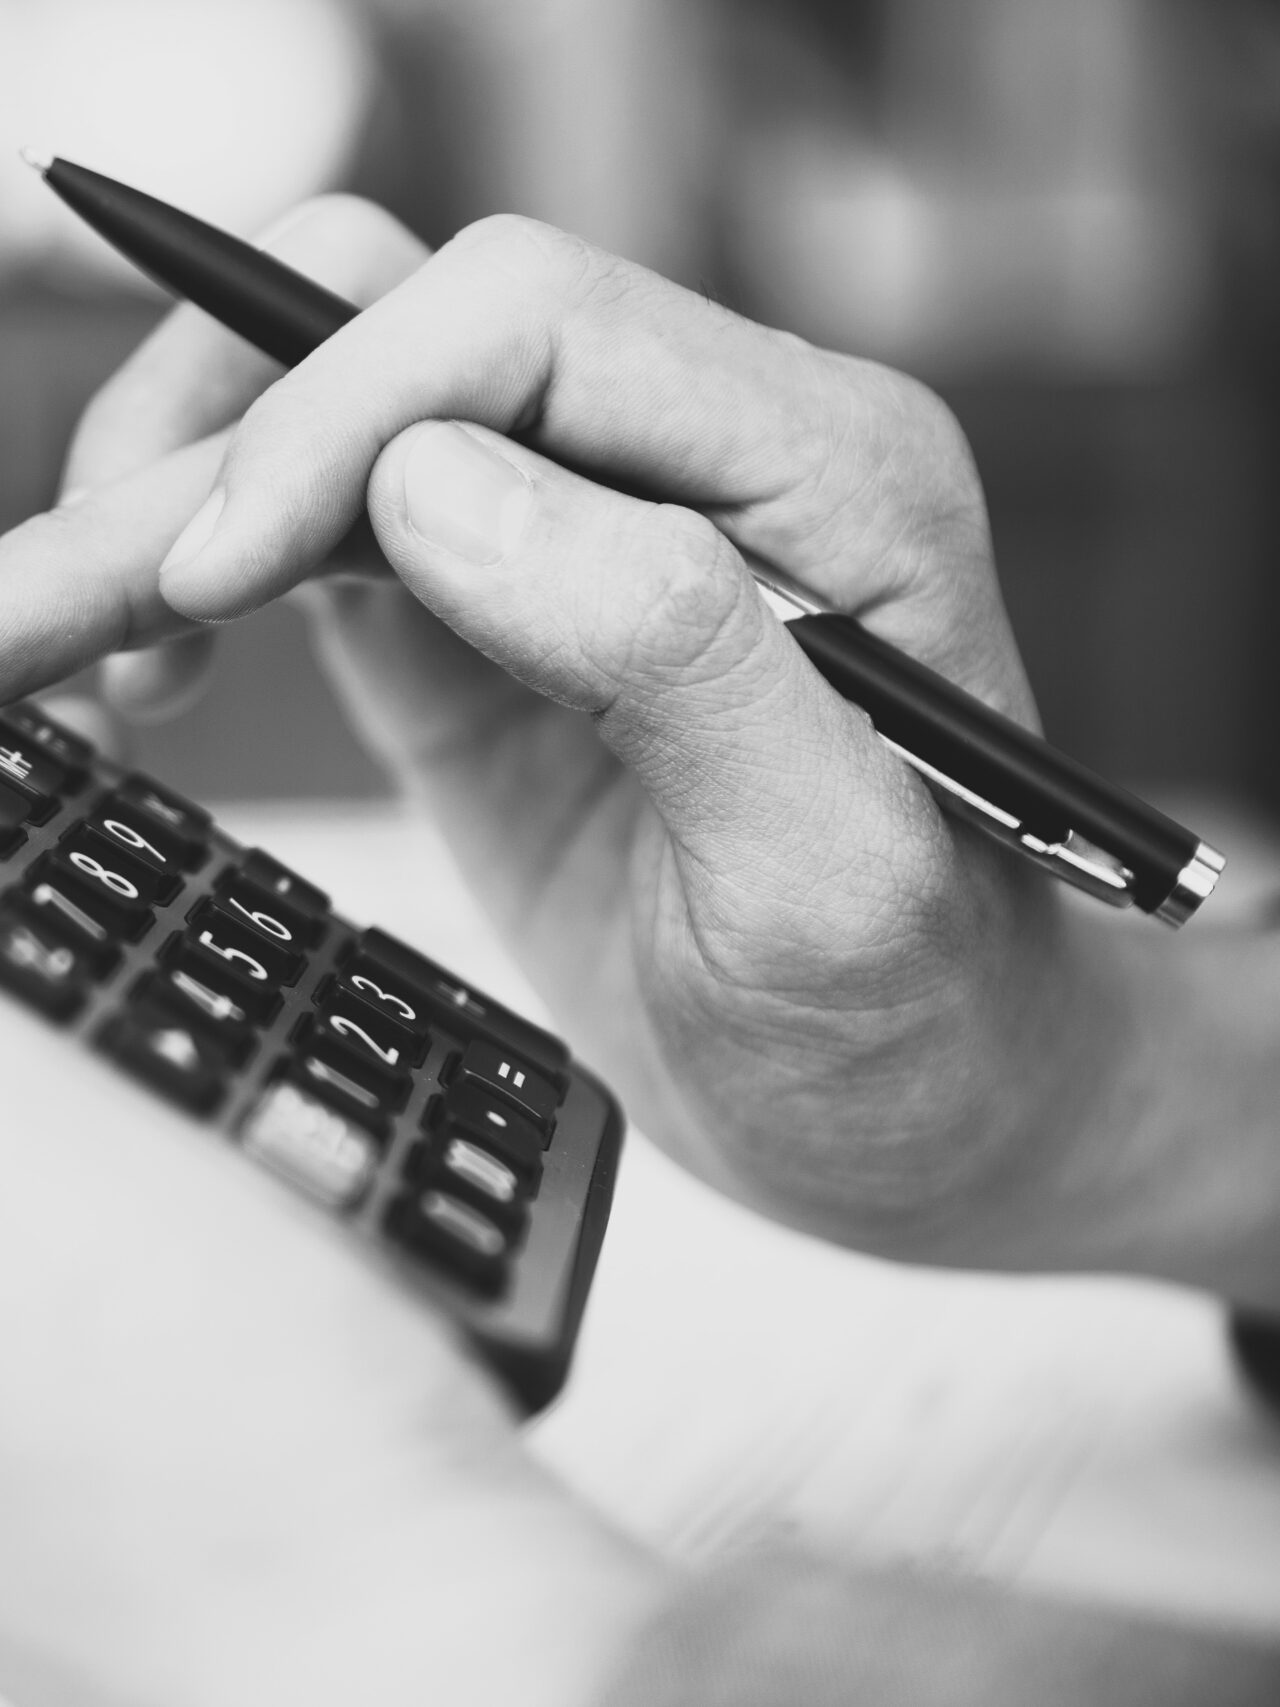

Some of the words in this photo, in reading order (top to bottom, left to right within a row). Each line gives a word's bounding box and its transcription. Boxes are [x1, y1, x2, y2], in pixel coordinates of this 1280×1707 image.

[103, 819, 166, 862] 9
[69, 852, 139, 898] 8
[34, 883, 108, 940] 7
[229, 897, 292, 941] 6
[199, 930, 268, 980] 5
[172, 970, 246, 1021] 4
[351, 975, 417, 1020] 3
[329, 1015, 400, 1065] 2
[305, 1056, 380, 1108] 1
